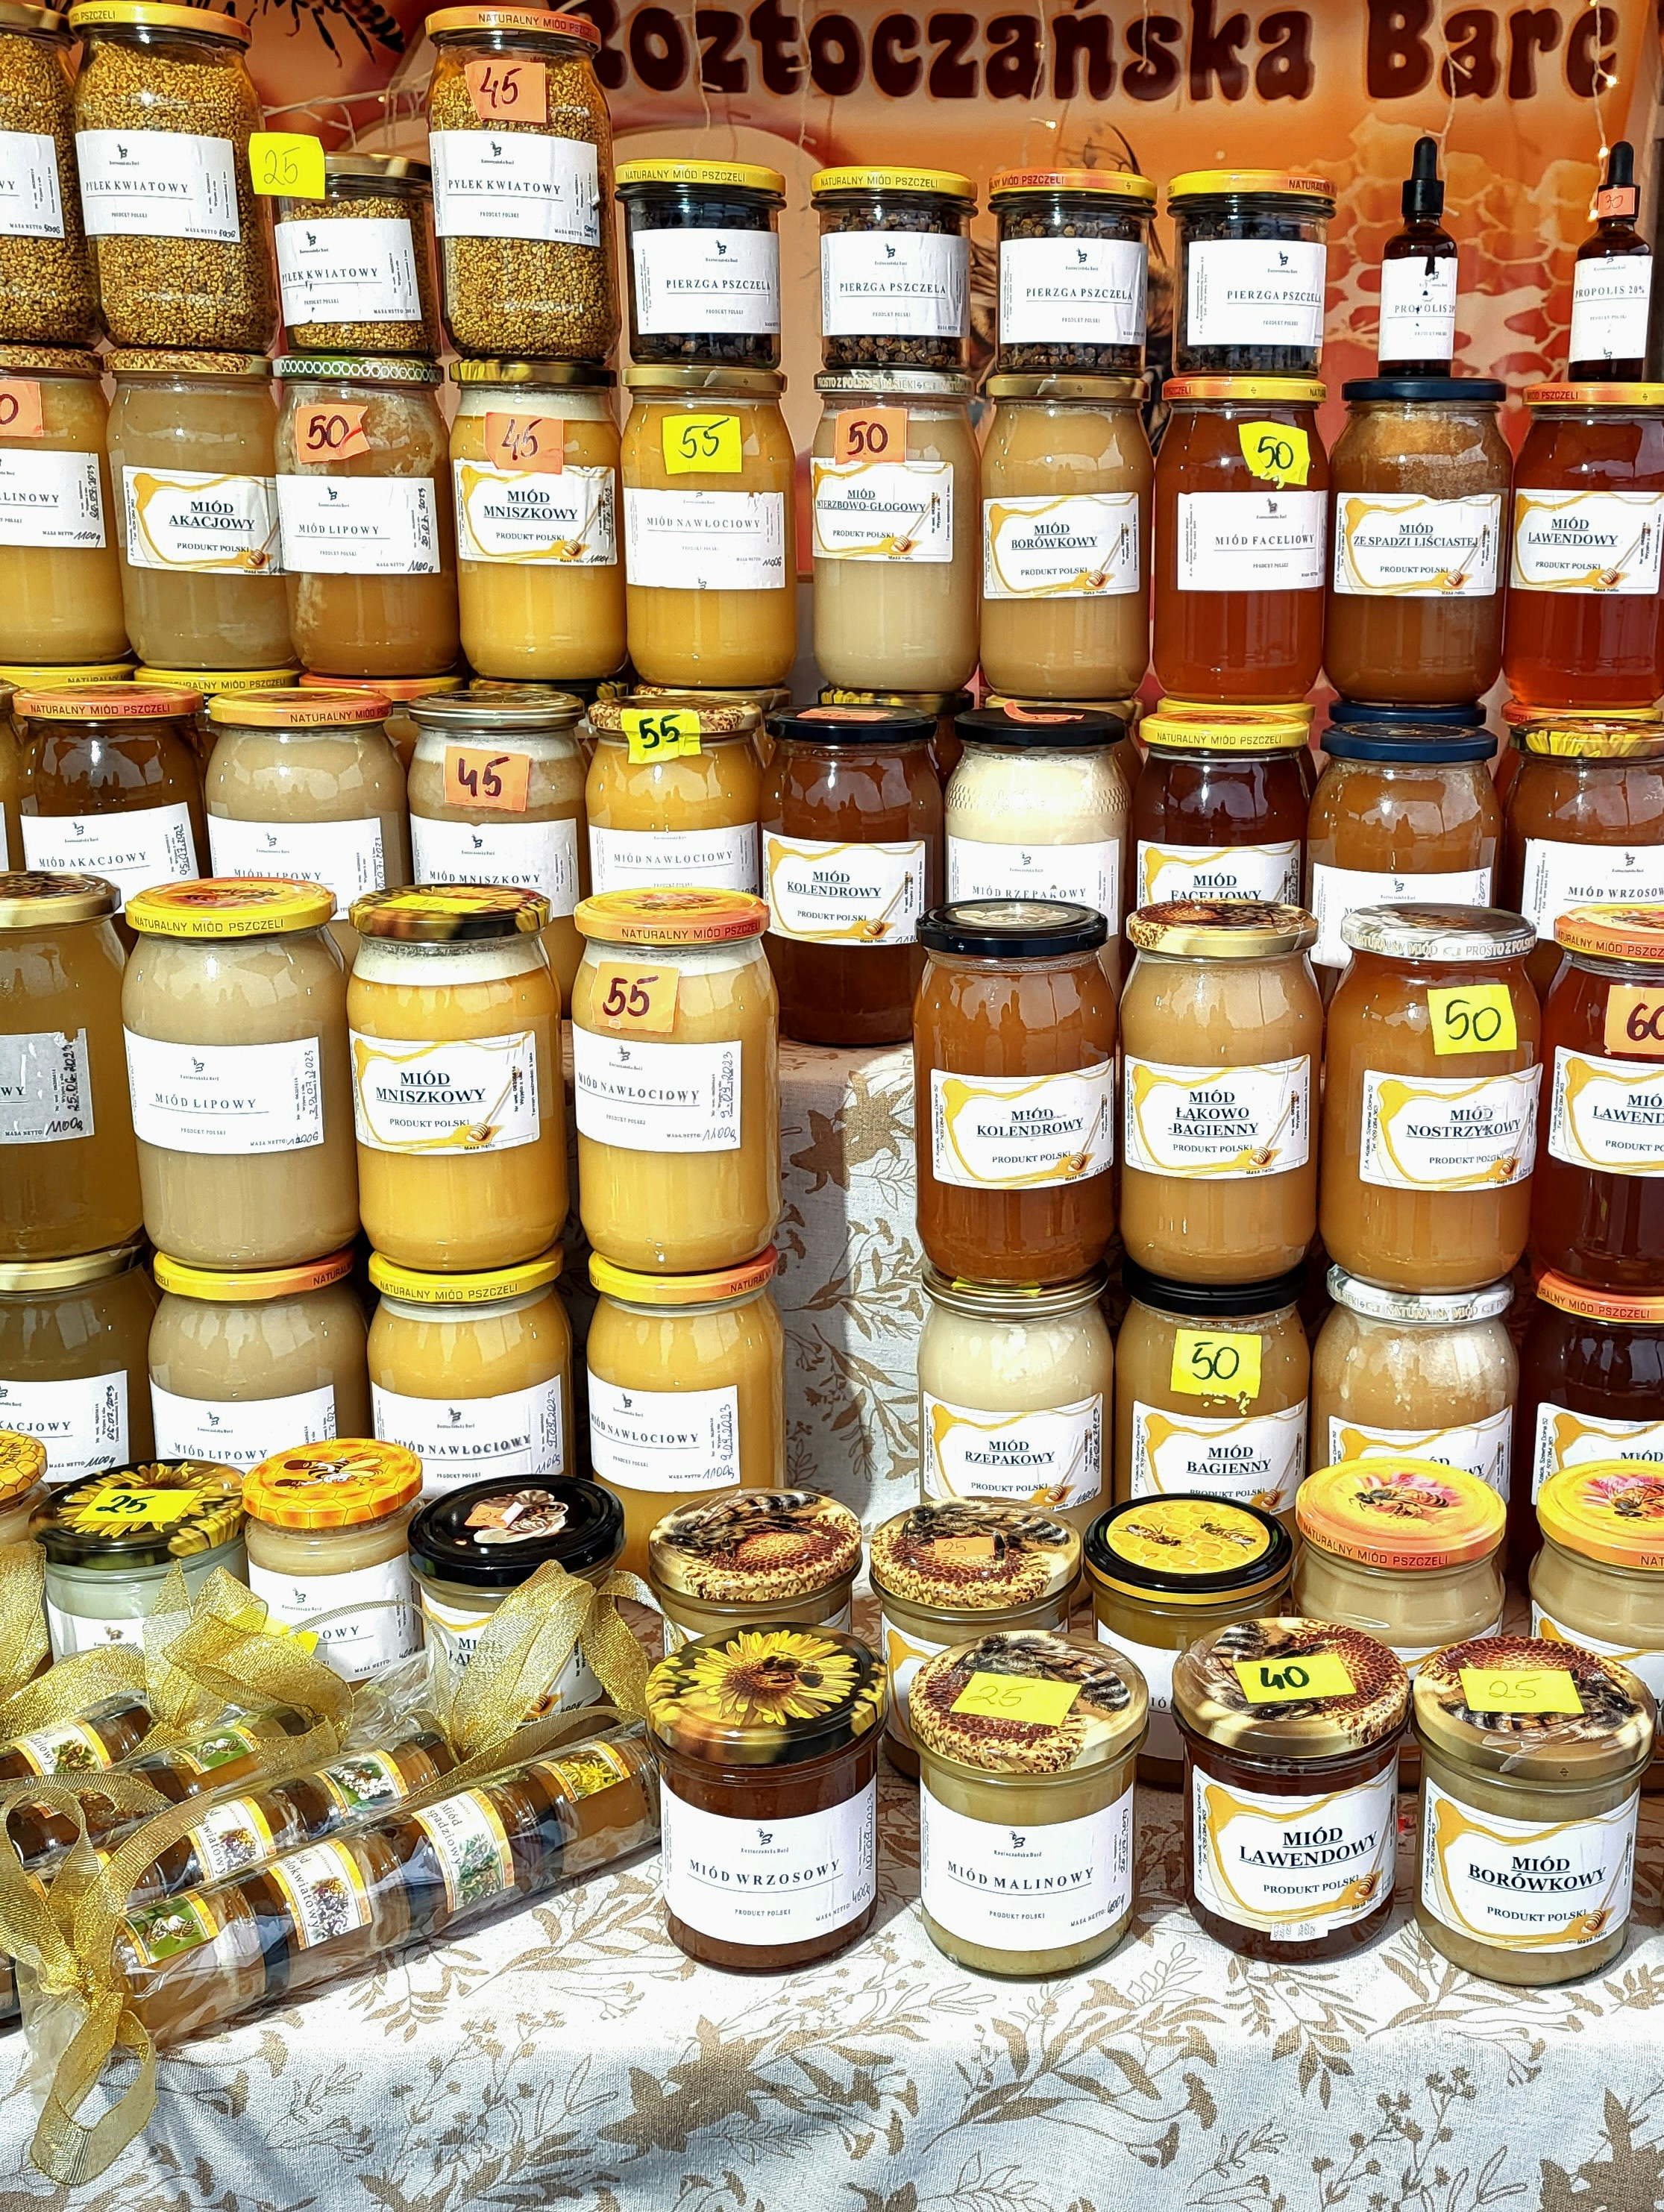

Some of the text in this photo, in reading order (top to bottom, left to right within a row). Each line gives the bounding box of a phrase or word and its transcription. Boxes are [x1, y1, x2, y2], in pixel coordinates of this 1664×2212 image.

[478, 13, 593, 36] NATURALNY MIÓD PSZCZ
[480, 66, 522, 108] 45
[264, 148, 301, 184] 25
[625, 170, 745, 183] NATURALNY MIÓD PSZCZELI
[821, 175, 938, 189] NATURALNY MIÓD PSZCZELI
[114, 181, 189, 194] KWIATOWY
[486, 180, 561, 195] KWIATOWY
[1604, 193, 1624, 209] 30
[667, 280, 718, 289] PIERZGA
[840, 283, 946, 295] PIERZGA PSZCZELA
[1575, 285, 1645, 298] PROPOLIS 20%
[1026, 288, 1132, 300] PIERZGA PSZCZELA
[1227, 290, 1279, 301] PIERZGA
[0, 393, 19, 424] 0
[305, 415, 350, 450] 50
[500, 418, 543, 460] 45
[679, 418, 730, 459] 55
[847, 421, 889, 455] 50
[1258, 436, 1294, 471] 50
[507, 488, 550, 503] MIÓD
[847, 488, 876, 499] MIÓD
[190, 500, 234, 513] MIÓD
[483, 505, 578, 521] MNISZKOWY
[169, 515, 255, 530] AKACJOWY
[299, 524, 380, 535] MIÓD LIPOWY
[1034, 522, 1070, 535] MIÓD
[1399, 522, 1434, 533] MIÓD
[1551, 518, 1589, 530] MIÓD
[1011, 536, 1098, 549] BORÓWKOWY
[1216, 533, 1314, 545] MIÓD FACELIOWY
[1354, 534, 1478, 548] ZE SPADZI LIŚCIASTEJ
[1528, 532, 1618, 547] LAWENDOWY
[31, 703, 170, 714] NATURALNY MIÓD PSZCZELI
[639, 714, 680, 750] 55
[1157, 733, 1282, 745] NATURALNY MIÓD PSZCZELI
[458, 756, 510, 797] 45
[39, 852, 147, 868] MIÓD AKACJOWY
[430, 870, 541, 884] MIÓD MNISZKOWY
[812, 871, 850, 882] MIÓD
[1193, 873, 1237, 887] MIÓD
[787, 882, 881, 897] KOLENDROWY
[973, 886, 1087, 899] MIÓD RZEPAKOWY
[1569, 887, 1664, 899] MIÓD WRZOSOW
[135, 917, 284, 932] NATURALNY MIÓD PSZCZELI
[622, 922, 761, 940] NATURALNY MIÓD PSZCZELI
[603, 975, 659, 1017] 55
[1445, 999, 1501, 1042] 50
[400, 1071, 450, 1086] MIÓD
[578, 1072, 597, 1090] MIÓD
[155, 1093, 257, 1109] MIÓD LIPOWY
[376, 1087, 486, 1102] MNISZKOWY
[1189, 1091, 1234, 1103] MIÓD
[1627, 1094, 1664, 1108] MIÓ
[1176, 1107, 1249, 1121] ŁĄKOWO
[1449, 1107, 1493, 1121] MIÓD
[1592, 1105, 1664, 1125] LAWEND
[977, 1117, 1084, 1137] KOLENDROWY
[1167, 1122, 1259, 1136] -BAGIENNY
[1406, 1119, 1521, 1137] NOSTRZYKOWY
[1605, 1140, 1650, 1150] PRODUKT
[380, 1281, 518, 1300] NATURALNY MIÓD PSZCZELI
[1569, 1299, 1650, 1319] MIÓD PSZCZELI
[1191, 1342, 1240, 1380] 50
[174, 1442, 268, 1461] MIÓD LIPOWY
[989, 1439, 1030, 1452] MIÓD
[1208, 1445, 1254, 1459] MIÓD
[964, 1451, 1054, 1465] RZEPAKOWY
[1187, 1459, 1272, 1474] BAGIENNY
[95, 1495, 157, 1514] 25
[941, 1542, 966, 1554] 25
[1302, 1522, 1448, 1567] NATURALNY MIÓD PSZCZELI
[1260, 1665, 1309, 1690] 40
[967, 1685, 1035, 1707] 25
[1489, 1677, 1542, 1700] 25
[439, 1803, 463, 1826] Miód
[427, 1809, 462, 1866] spadziowy
[1282, 1826, 1343, 1846] MIÓD
[1238, 1831, 1378, 1867] LAWENDOWY
[1512, 1856, 1570, 1872] MIÓD
[688, 1859, 840, 1885] MIÓD WRZOSOWY
[947, 1861, 1095, 1891] MIÓD MALINOWY
[1468, 1864, 1607, 1894] BORÓWKOWY
[1263, 1875, 1360, 1894] PRODUKT POLSKI
[815, 1913, 832, 1922] MASA
[1070, 1908, 1106, 1928] MASA NETTO:
[1486, 1907, 1587, 1922] PRODUKT POLSKI
